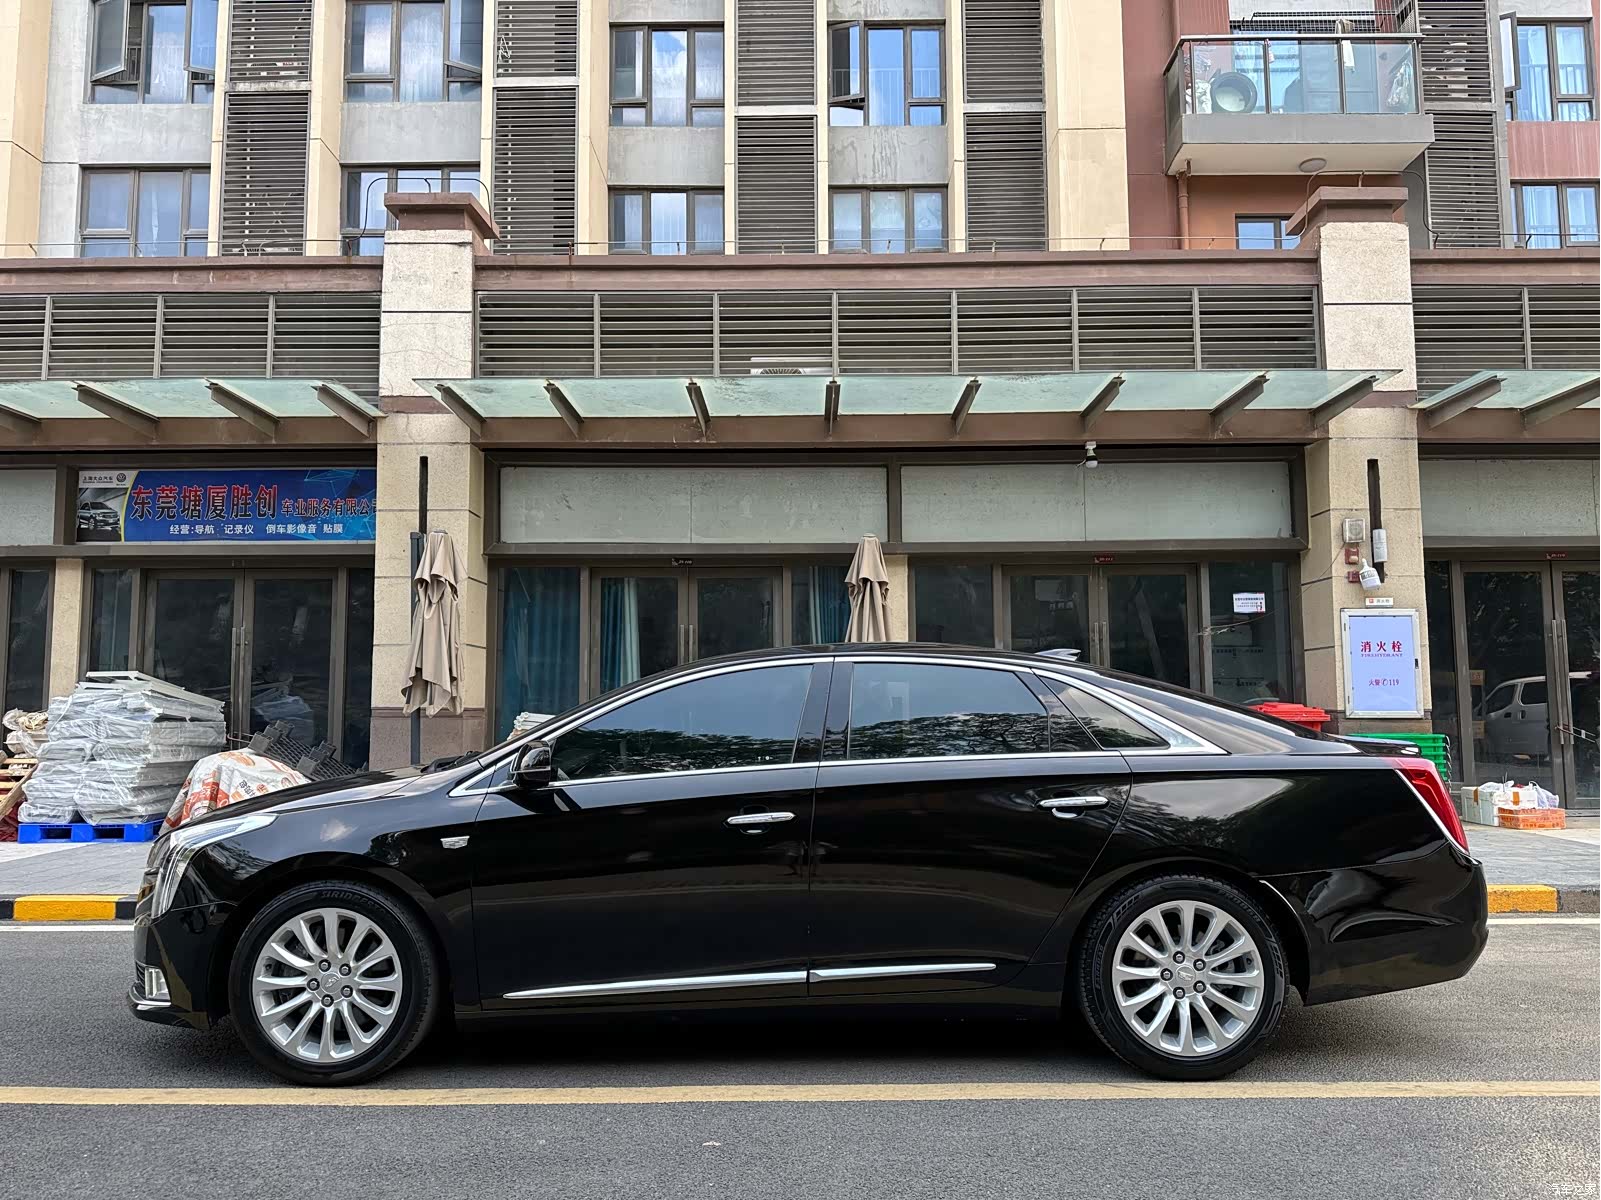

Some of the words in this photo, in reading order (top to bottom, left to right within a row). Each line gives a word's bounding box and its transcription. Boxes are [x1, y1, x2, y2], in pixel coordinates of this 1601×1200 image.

[130, 484, 278, 520] 东莞塘厦胜创
[224, 524, 254, 535] 记录仪
[266, 523, 318, 534] 倒车影像音
[323, 523, 344, 534] 贴膜
[1361, 641, 1402, 652] 消火栓
